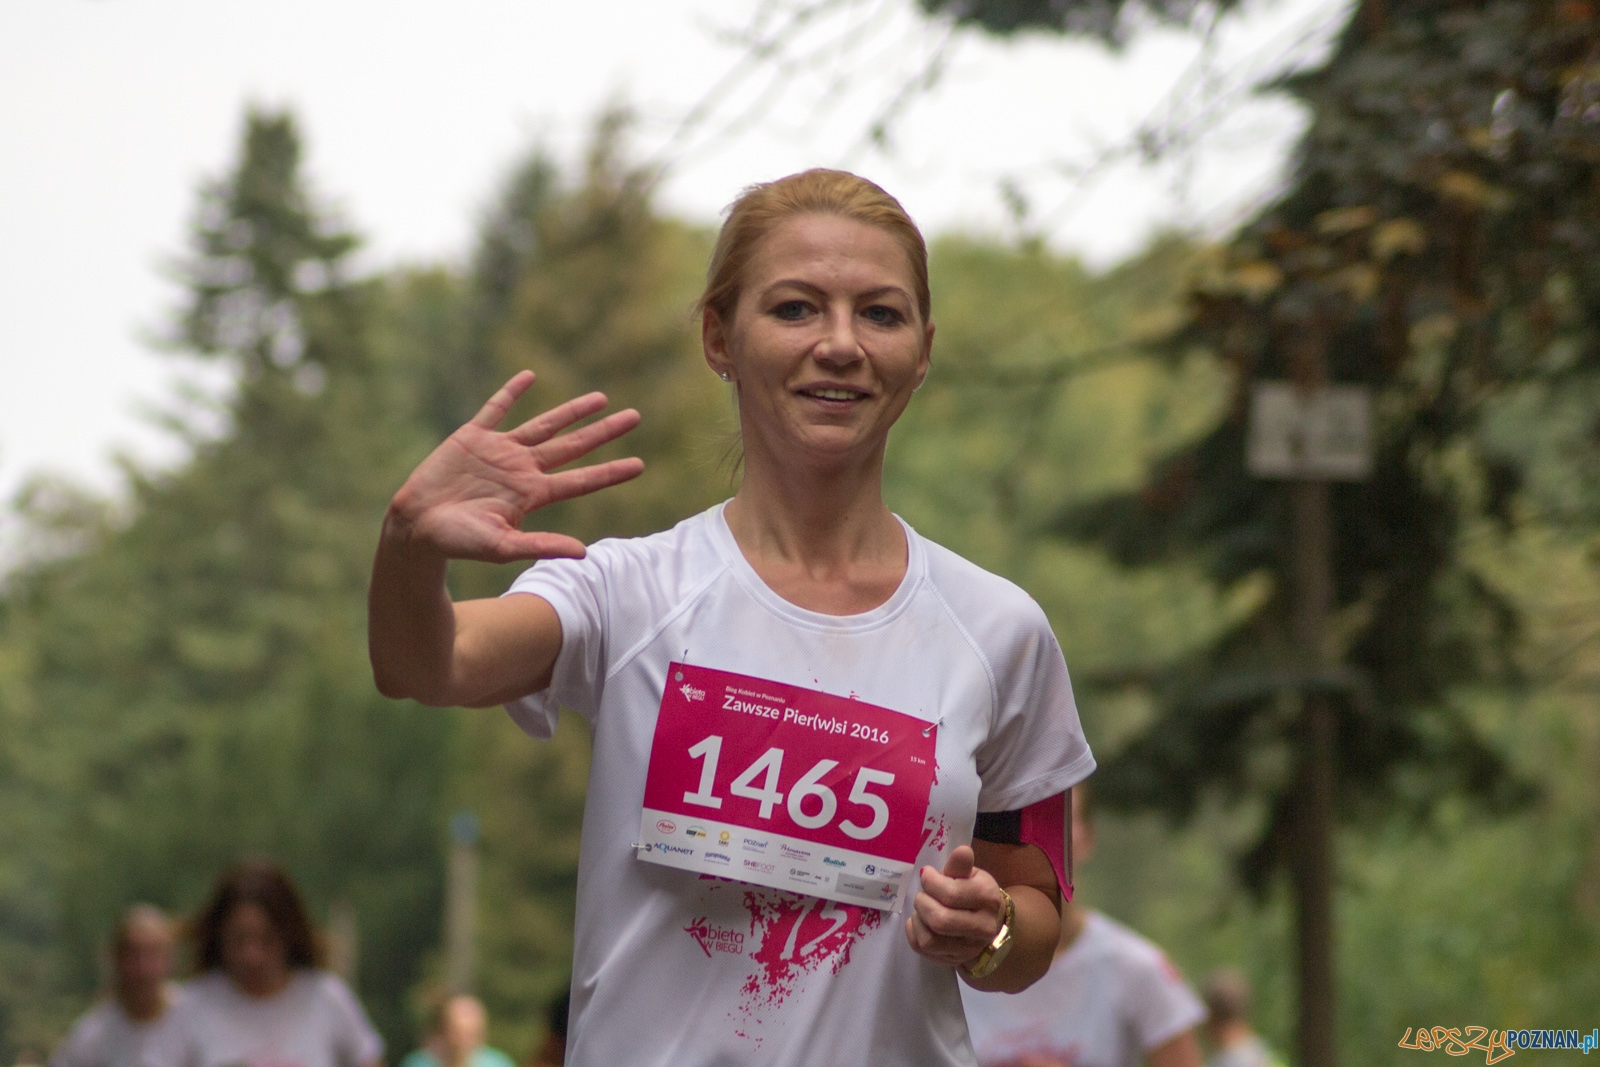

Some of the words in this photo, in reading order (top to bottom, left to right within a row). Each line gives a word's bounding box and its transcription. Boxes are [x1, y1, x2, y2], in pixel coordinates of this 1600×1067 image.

[725, 685, 738, 694] Bieg
[738, 688, 755, 697] Kobiet
[761, 693, 786, 704] Poznaniu
[722, 695, 780, 719] Zawsze
[783, 707, 848, 735] Pier(w)si
[850, 723, 889, 744] 2016
[917, 757, 926, 765] km
[682, 734, 896, 841] 1465
[743, 859, 775, 872] SHEFOOT
[715, 941, 743, 955] BIEGU
